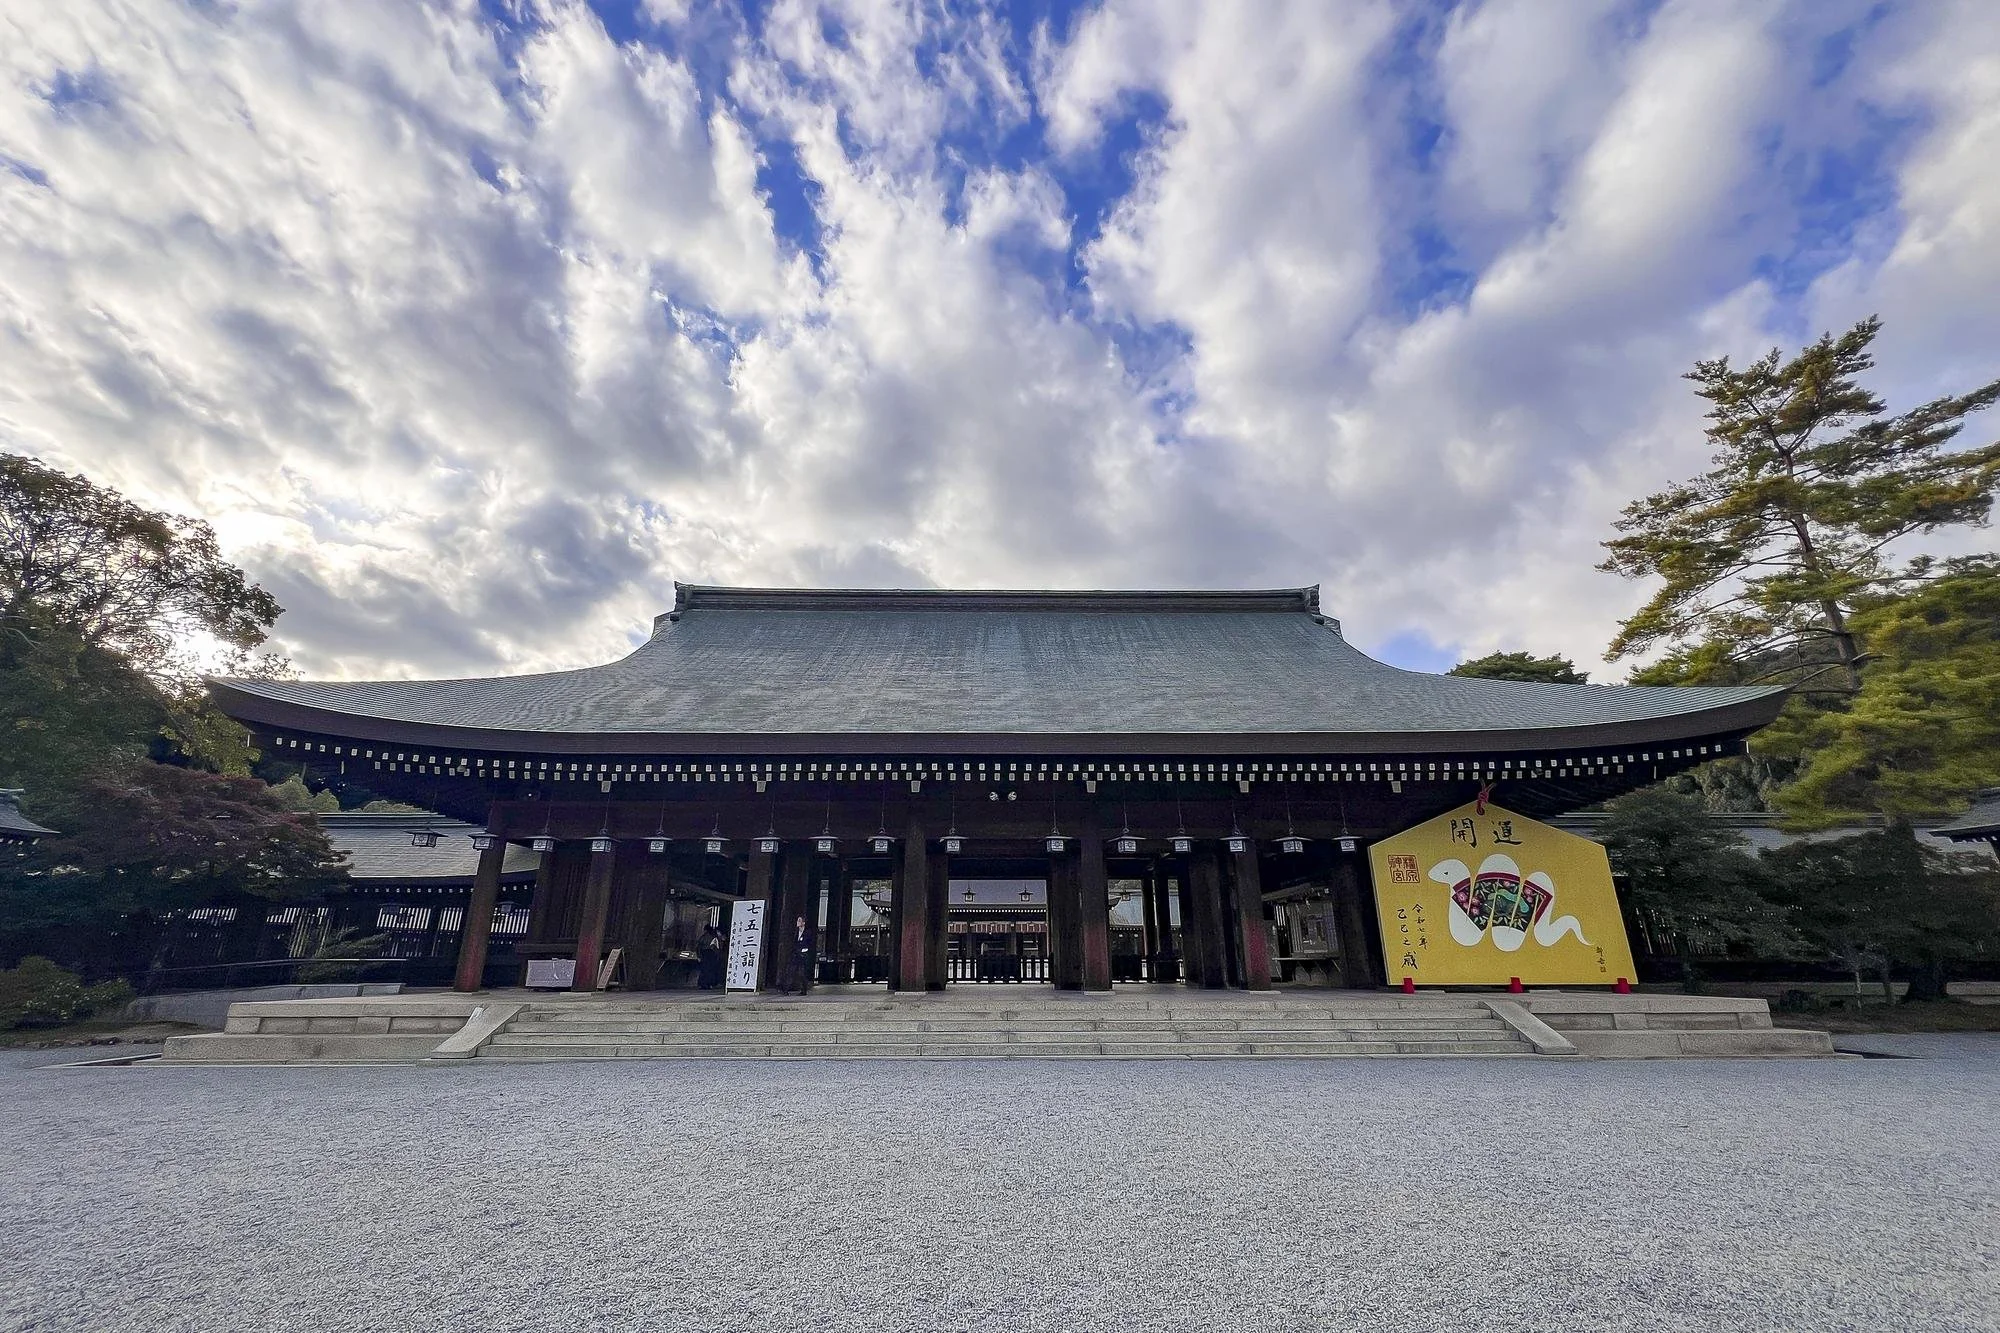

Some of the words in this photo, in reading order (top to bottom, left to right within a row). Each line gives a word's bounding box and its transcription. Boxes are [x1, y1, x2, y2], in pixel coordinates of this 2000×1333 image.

[1450, 817, 1523, 848] 開運
[741, 903, 761, 985] 七五三詣り
[1412, 903, 1428, 950] 令和七年
